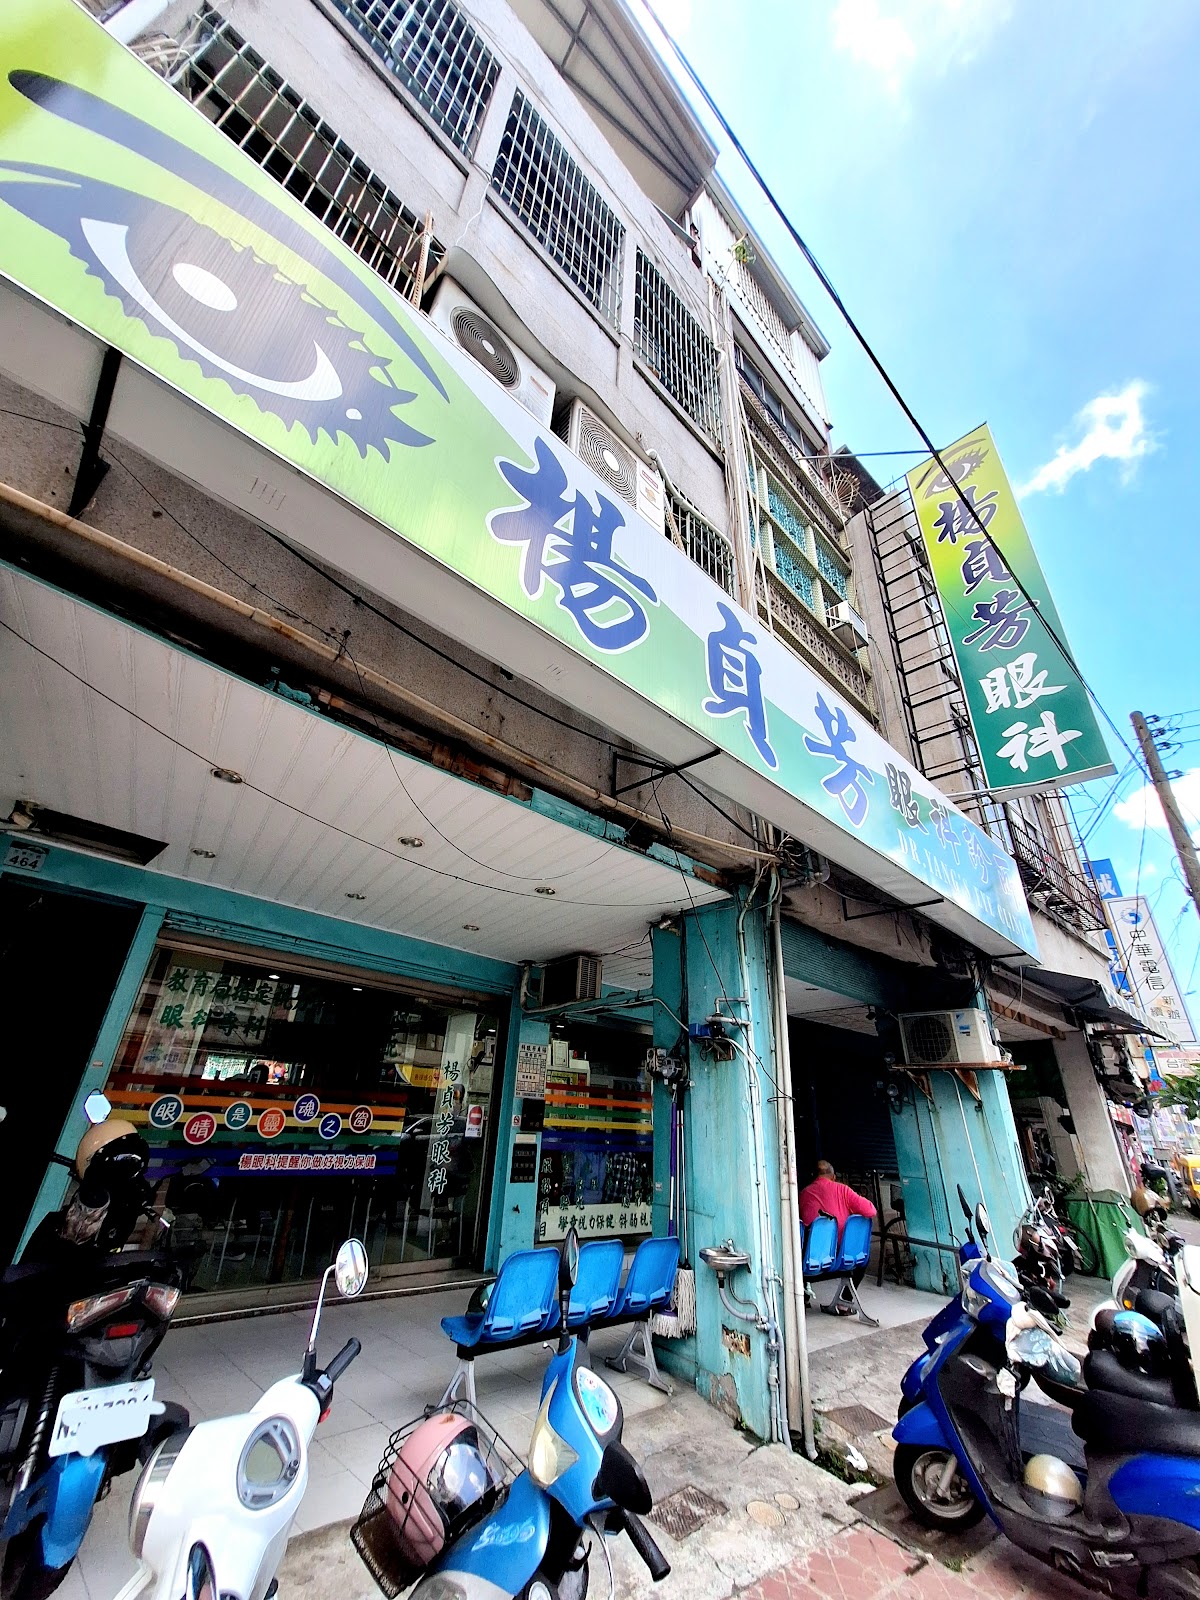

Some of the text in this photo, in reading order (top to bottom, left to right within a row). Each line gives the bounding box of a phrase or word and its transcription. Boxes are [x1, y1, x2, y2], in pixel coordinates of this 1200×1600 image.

[487, 434, 875, 828] 楊貞芳
[932, 486, 1083, 772] 楊貞芳眼科
[9, 855, 39, 869] 464
[1129, 930, 1165, 991] 中華電信
[427, 1061, 460, 1195] 楊貞芳眼科
